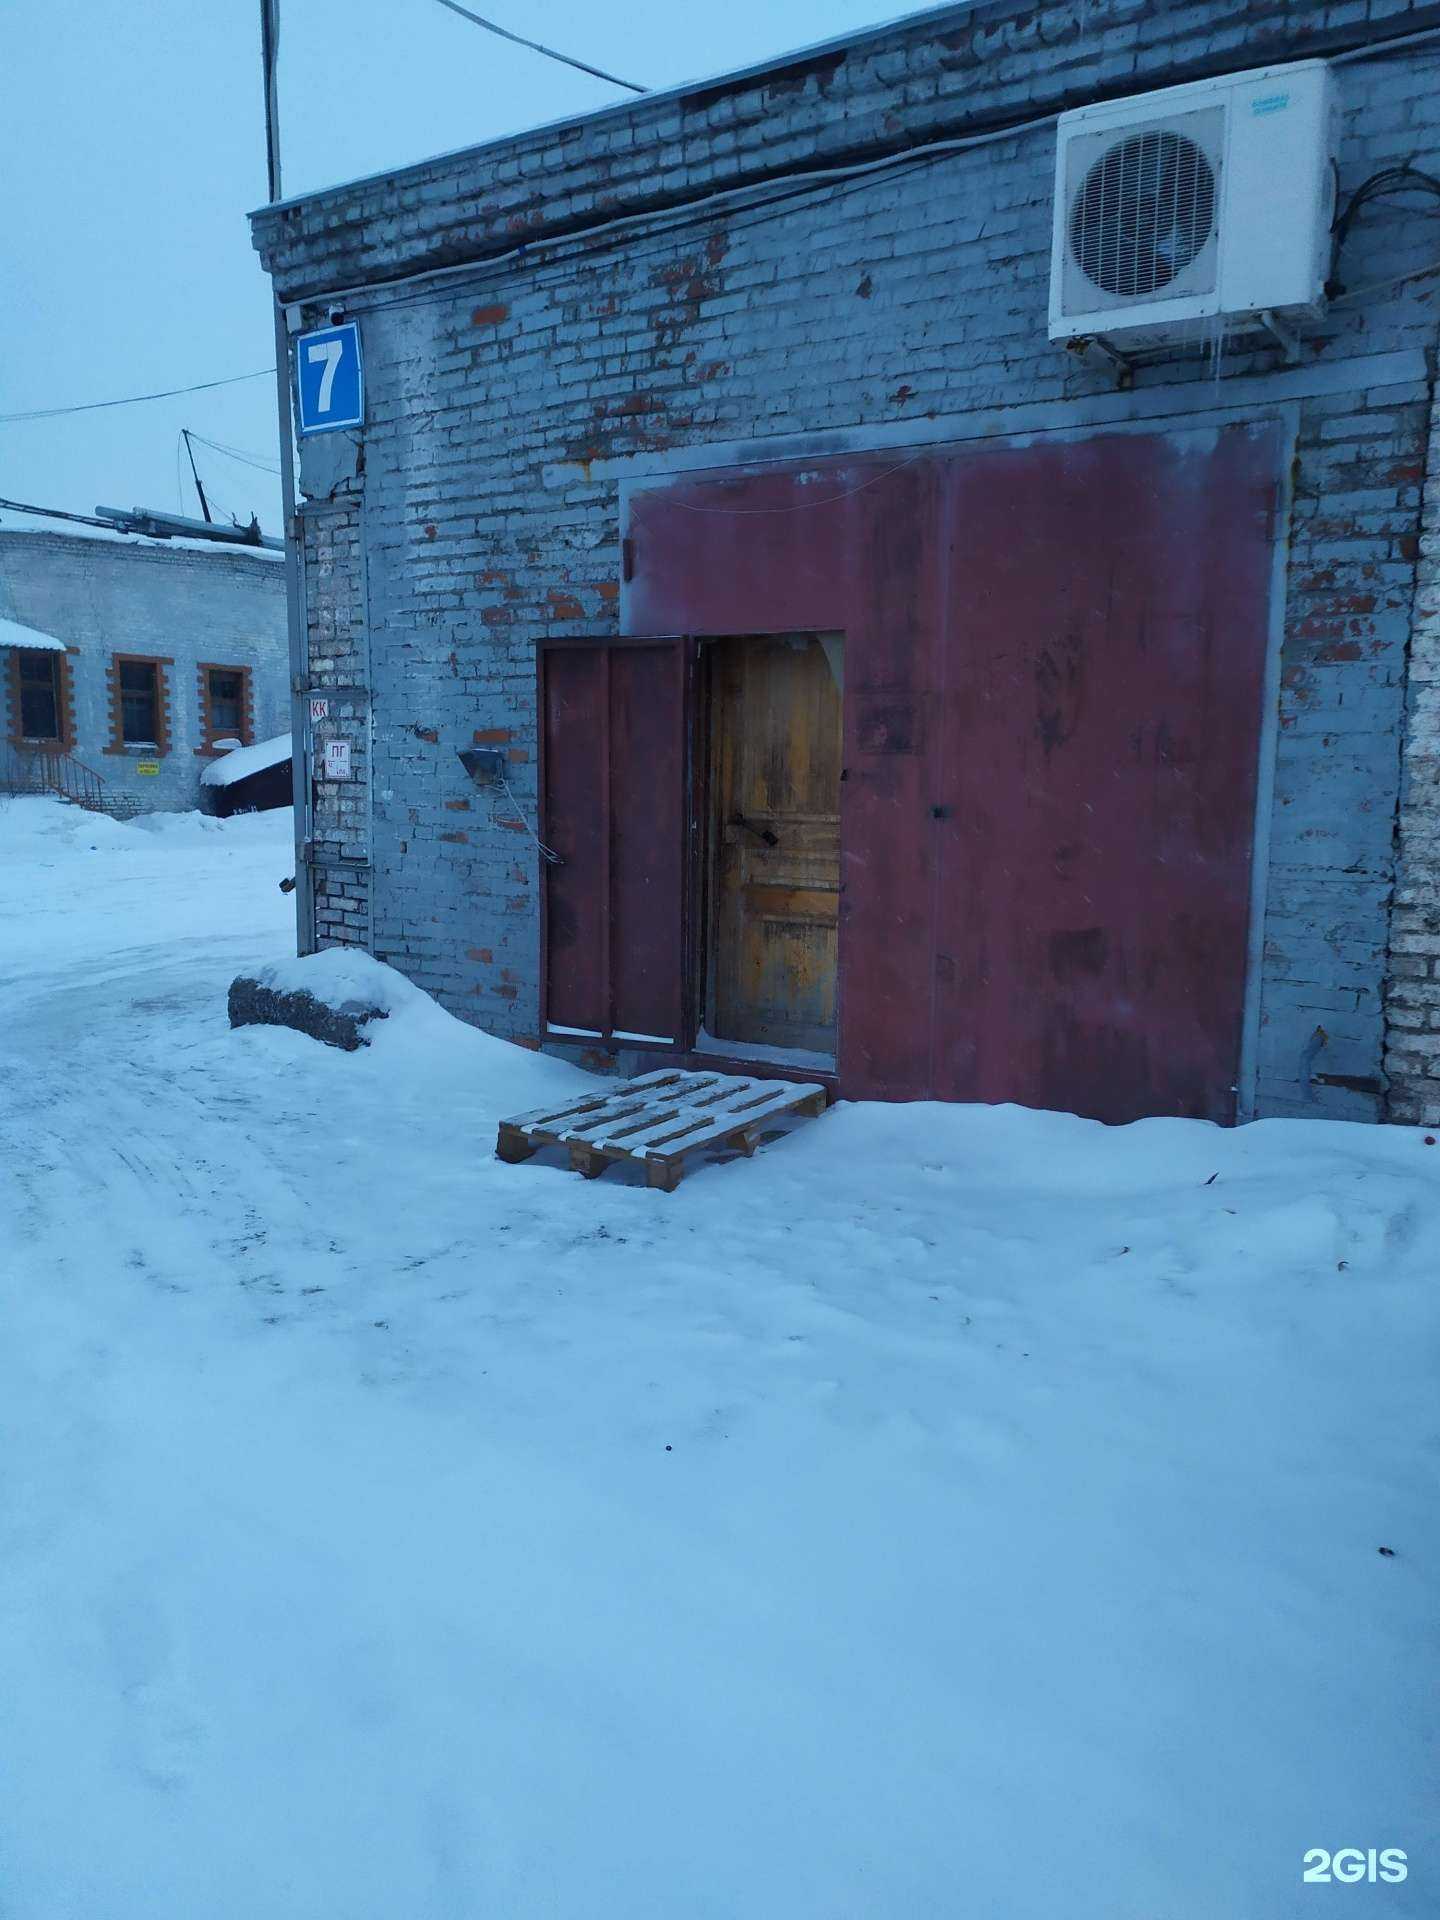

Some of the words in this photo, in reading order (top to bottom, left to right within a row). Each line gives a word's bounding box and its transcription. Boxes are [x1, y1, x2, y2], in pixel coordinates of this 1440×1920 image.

[308, 339, 343, 413] 7
[312, 701, 326, 716] КК
[332, 745, 345, 757] ПГ
